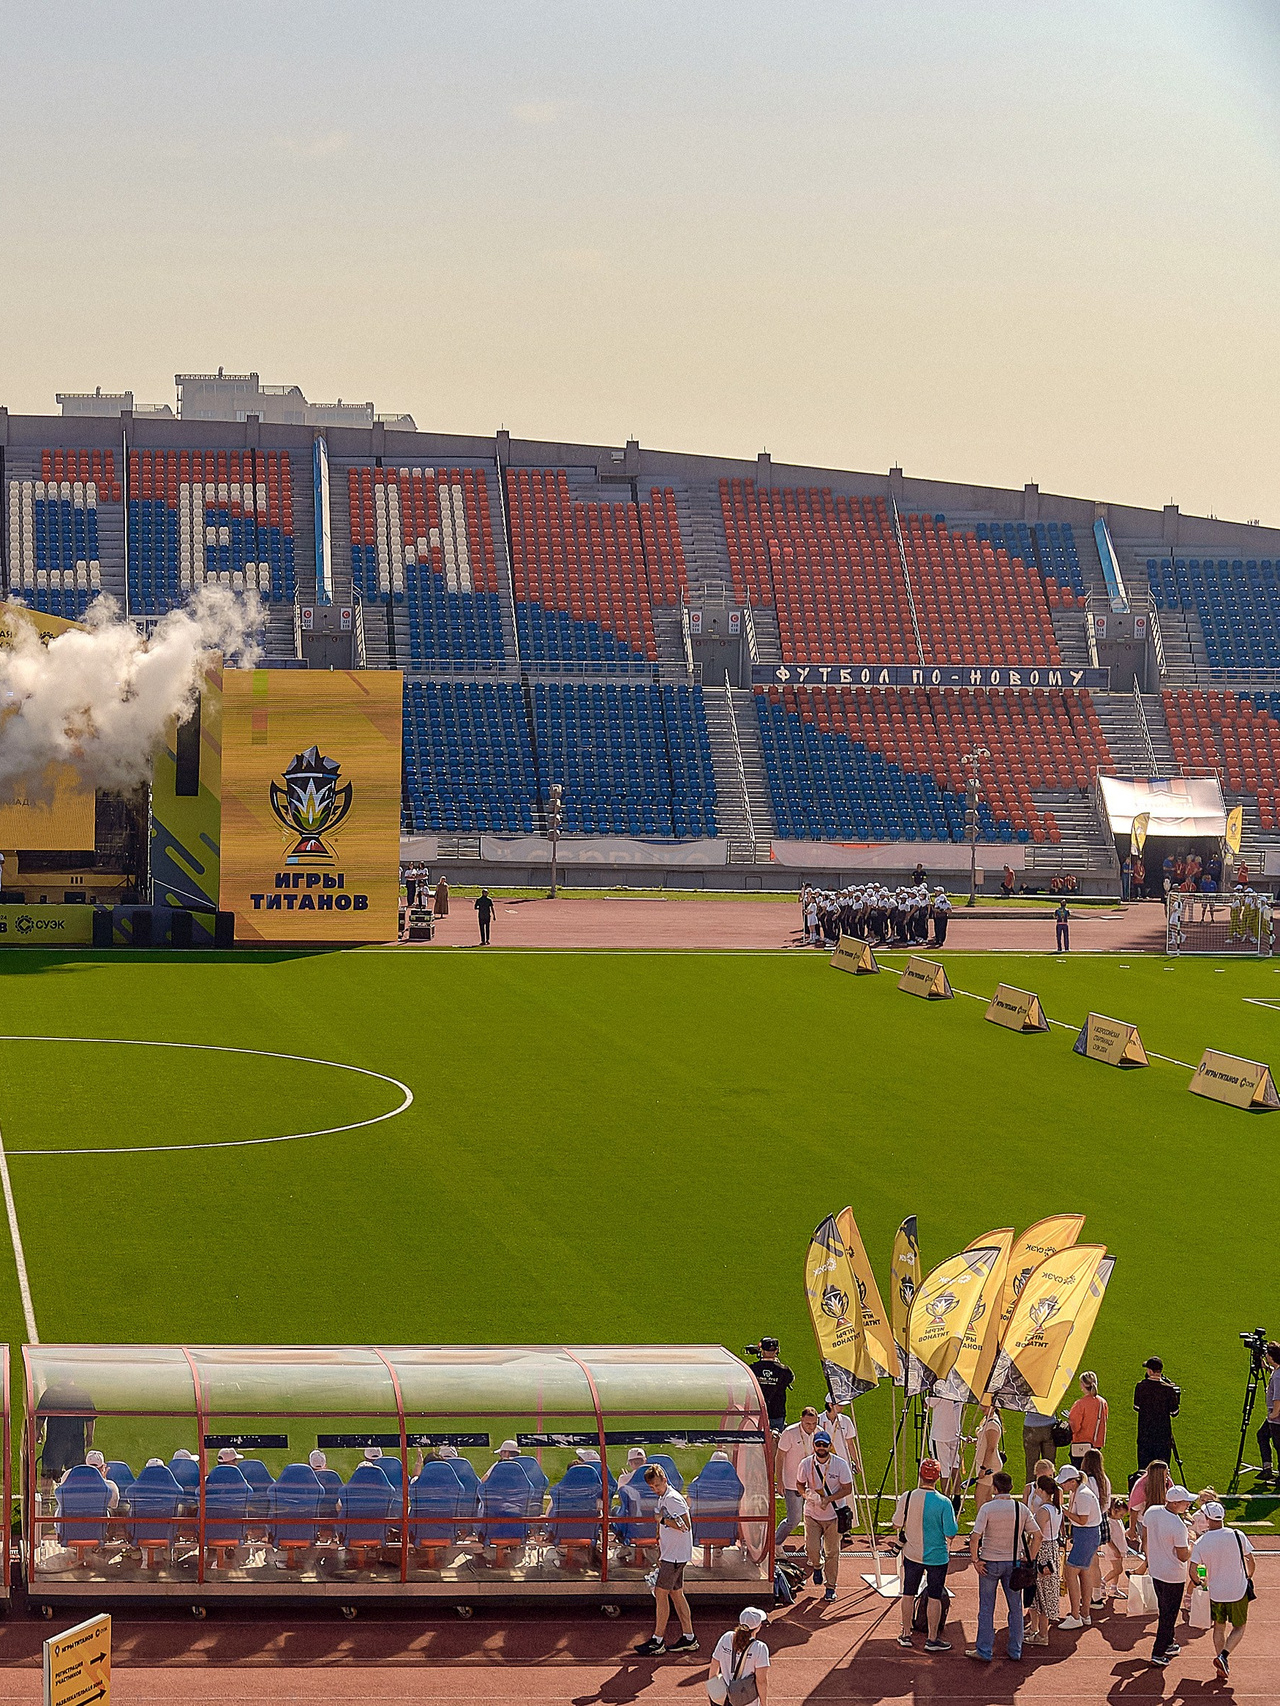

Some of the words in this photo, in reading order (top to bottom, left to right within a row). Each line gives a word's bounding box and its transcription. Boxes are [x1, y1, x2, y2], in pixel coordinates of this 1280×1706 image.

[775, 666, 891, 684] ФУТБОЛ
[911, 667, 1085, 686] ПО-НОВОМУ
[275, 872, 345, 889] ИГРЫ
[250, 894, 369, 911] ТИТАНОВ
[35, 919, 65, 930] СУЭК
[61, 1643, 74, 1654] ИГРЫ
